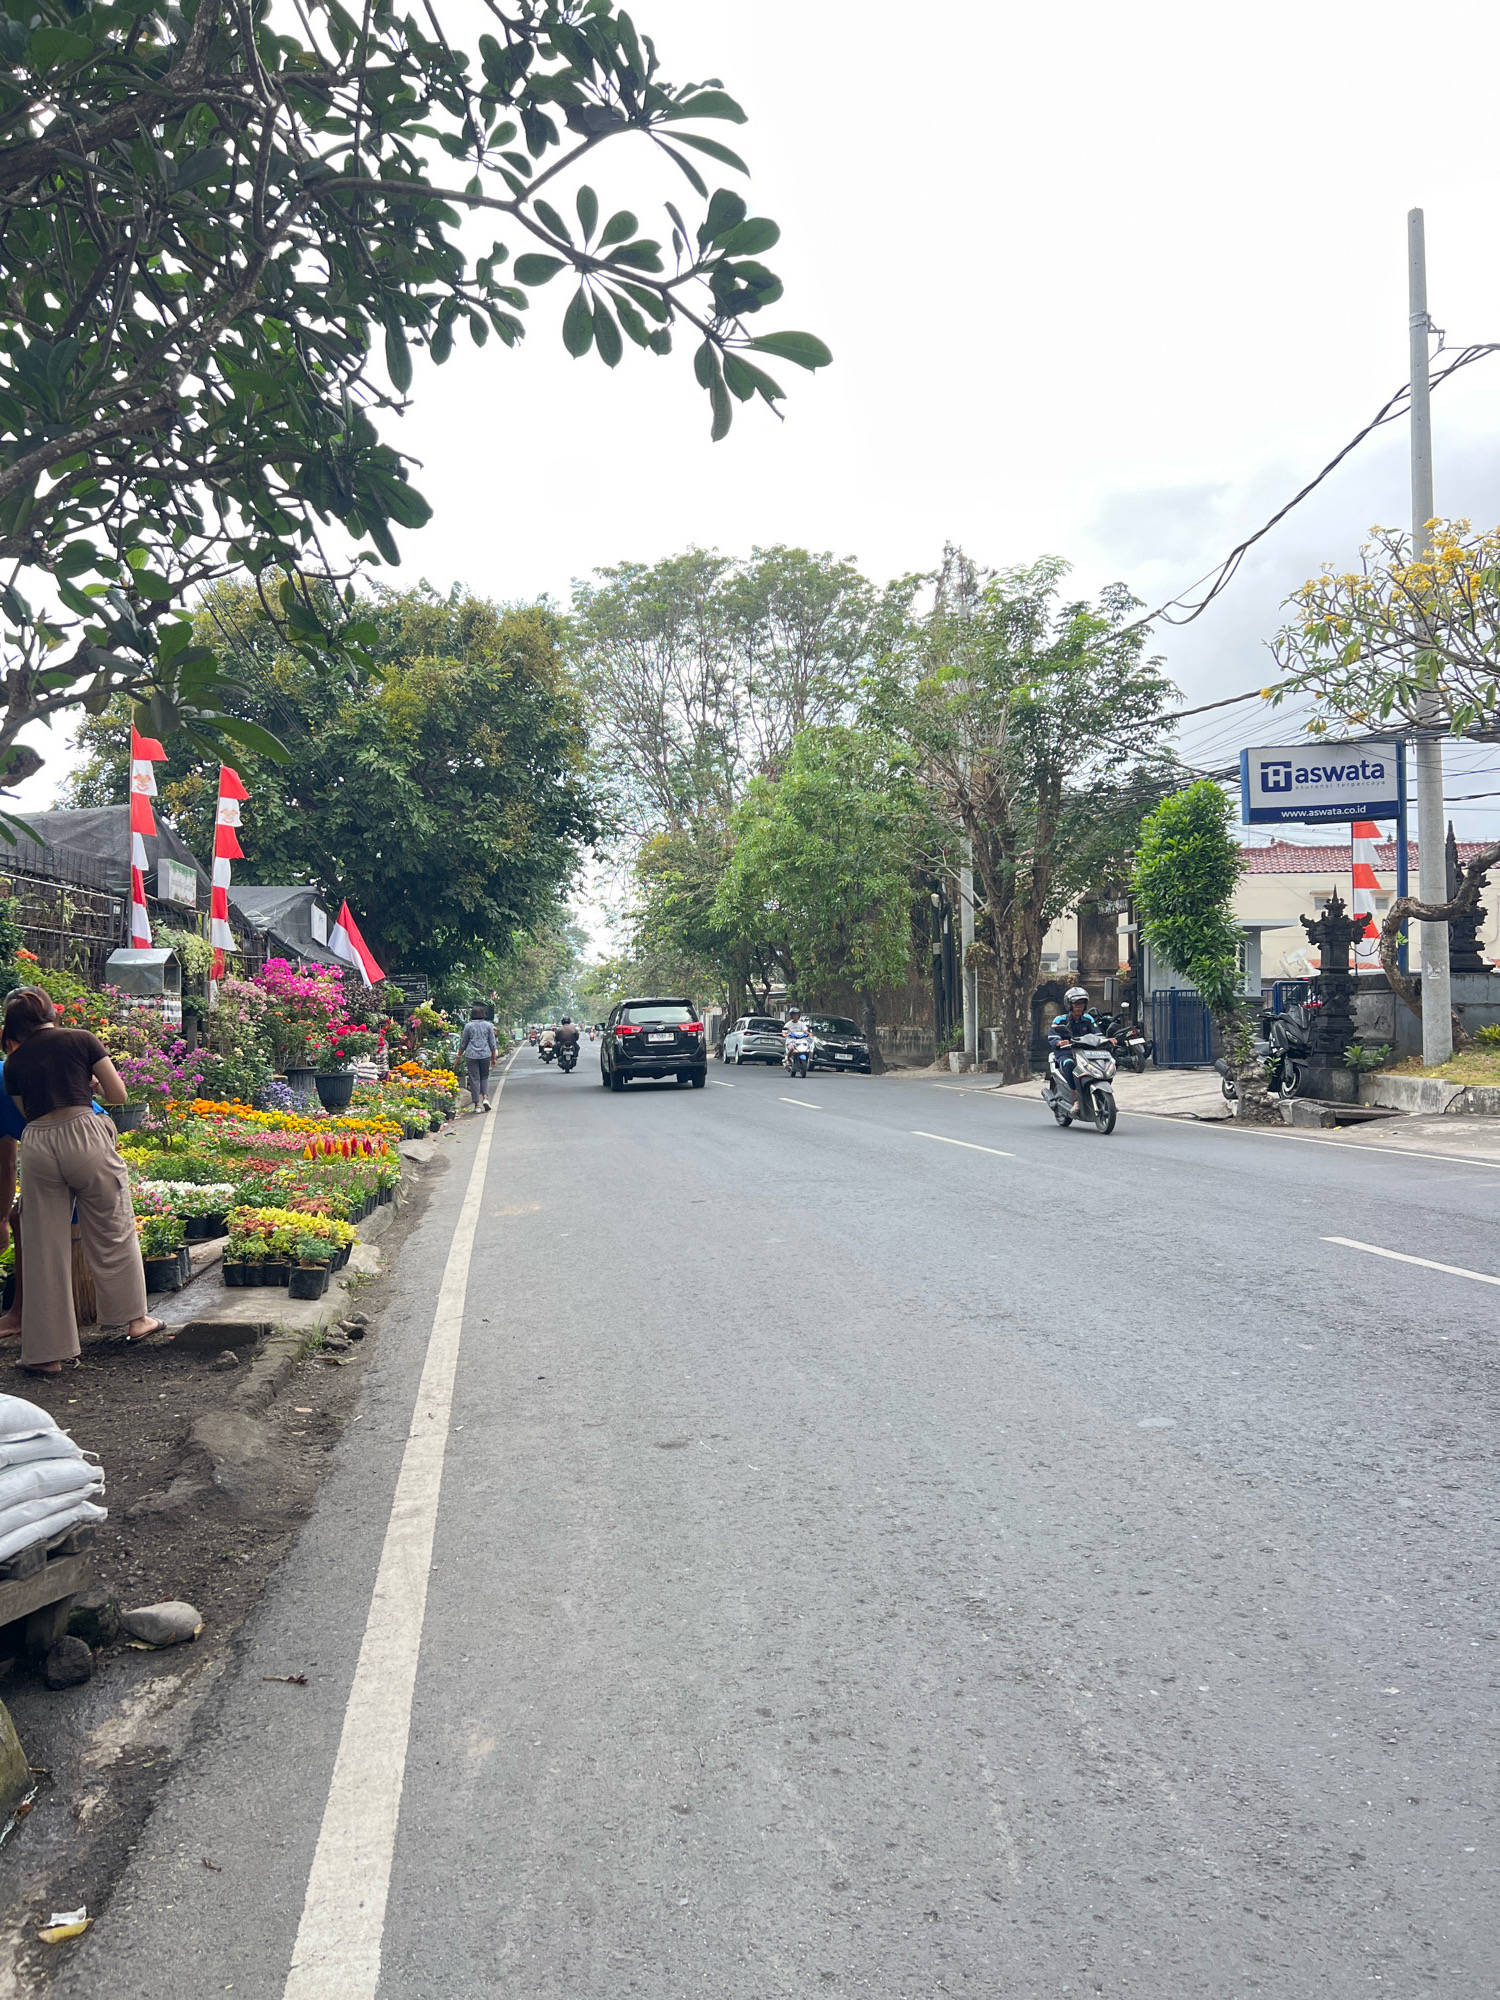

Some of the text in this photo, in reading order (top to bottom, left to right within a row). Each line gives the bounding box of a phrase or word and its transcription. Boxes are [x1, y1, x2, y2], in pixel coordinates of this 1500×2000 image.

[1295, 760, 1385, 783] aswata
[1337, 780, 1386, 788] terpercaya
[1281, 805, 1367, 818] www.aswata.co.id
